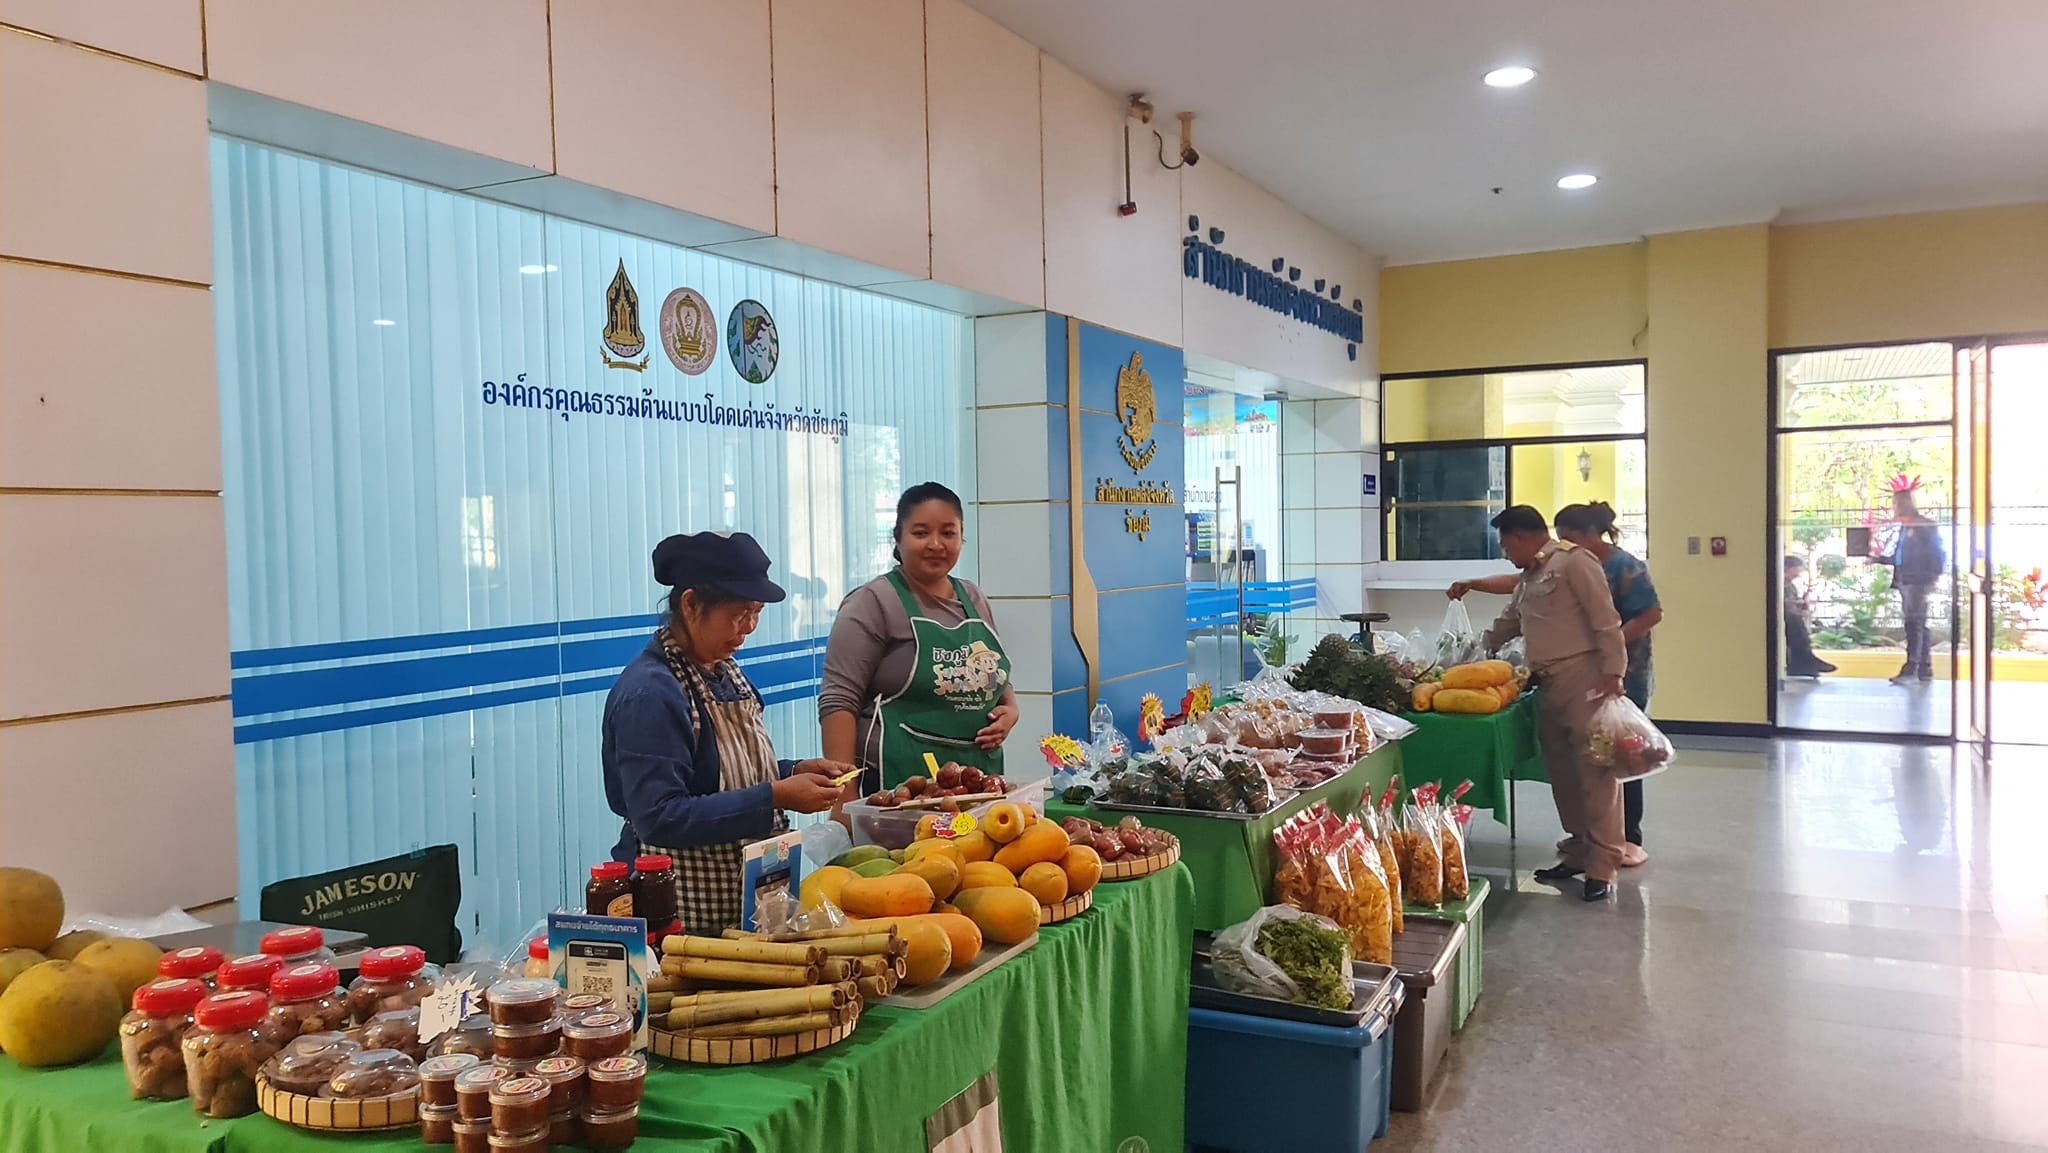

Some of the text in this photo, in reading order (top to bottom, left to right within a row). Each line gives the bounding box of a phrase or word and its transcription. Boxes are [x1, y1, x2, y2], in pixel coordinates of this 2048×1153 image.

[482, 372, 848, 444] องค์กรคุณธรรมต้นแบบโดดเด่นจังหวัดชัยภูมิ
[301, 871, 417, 916] JAMESON
[319, 894, 402, 921] IRISH WHISKEY
